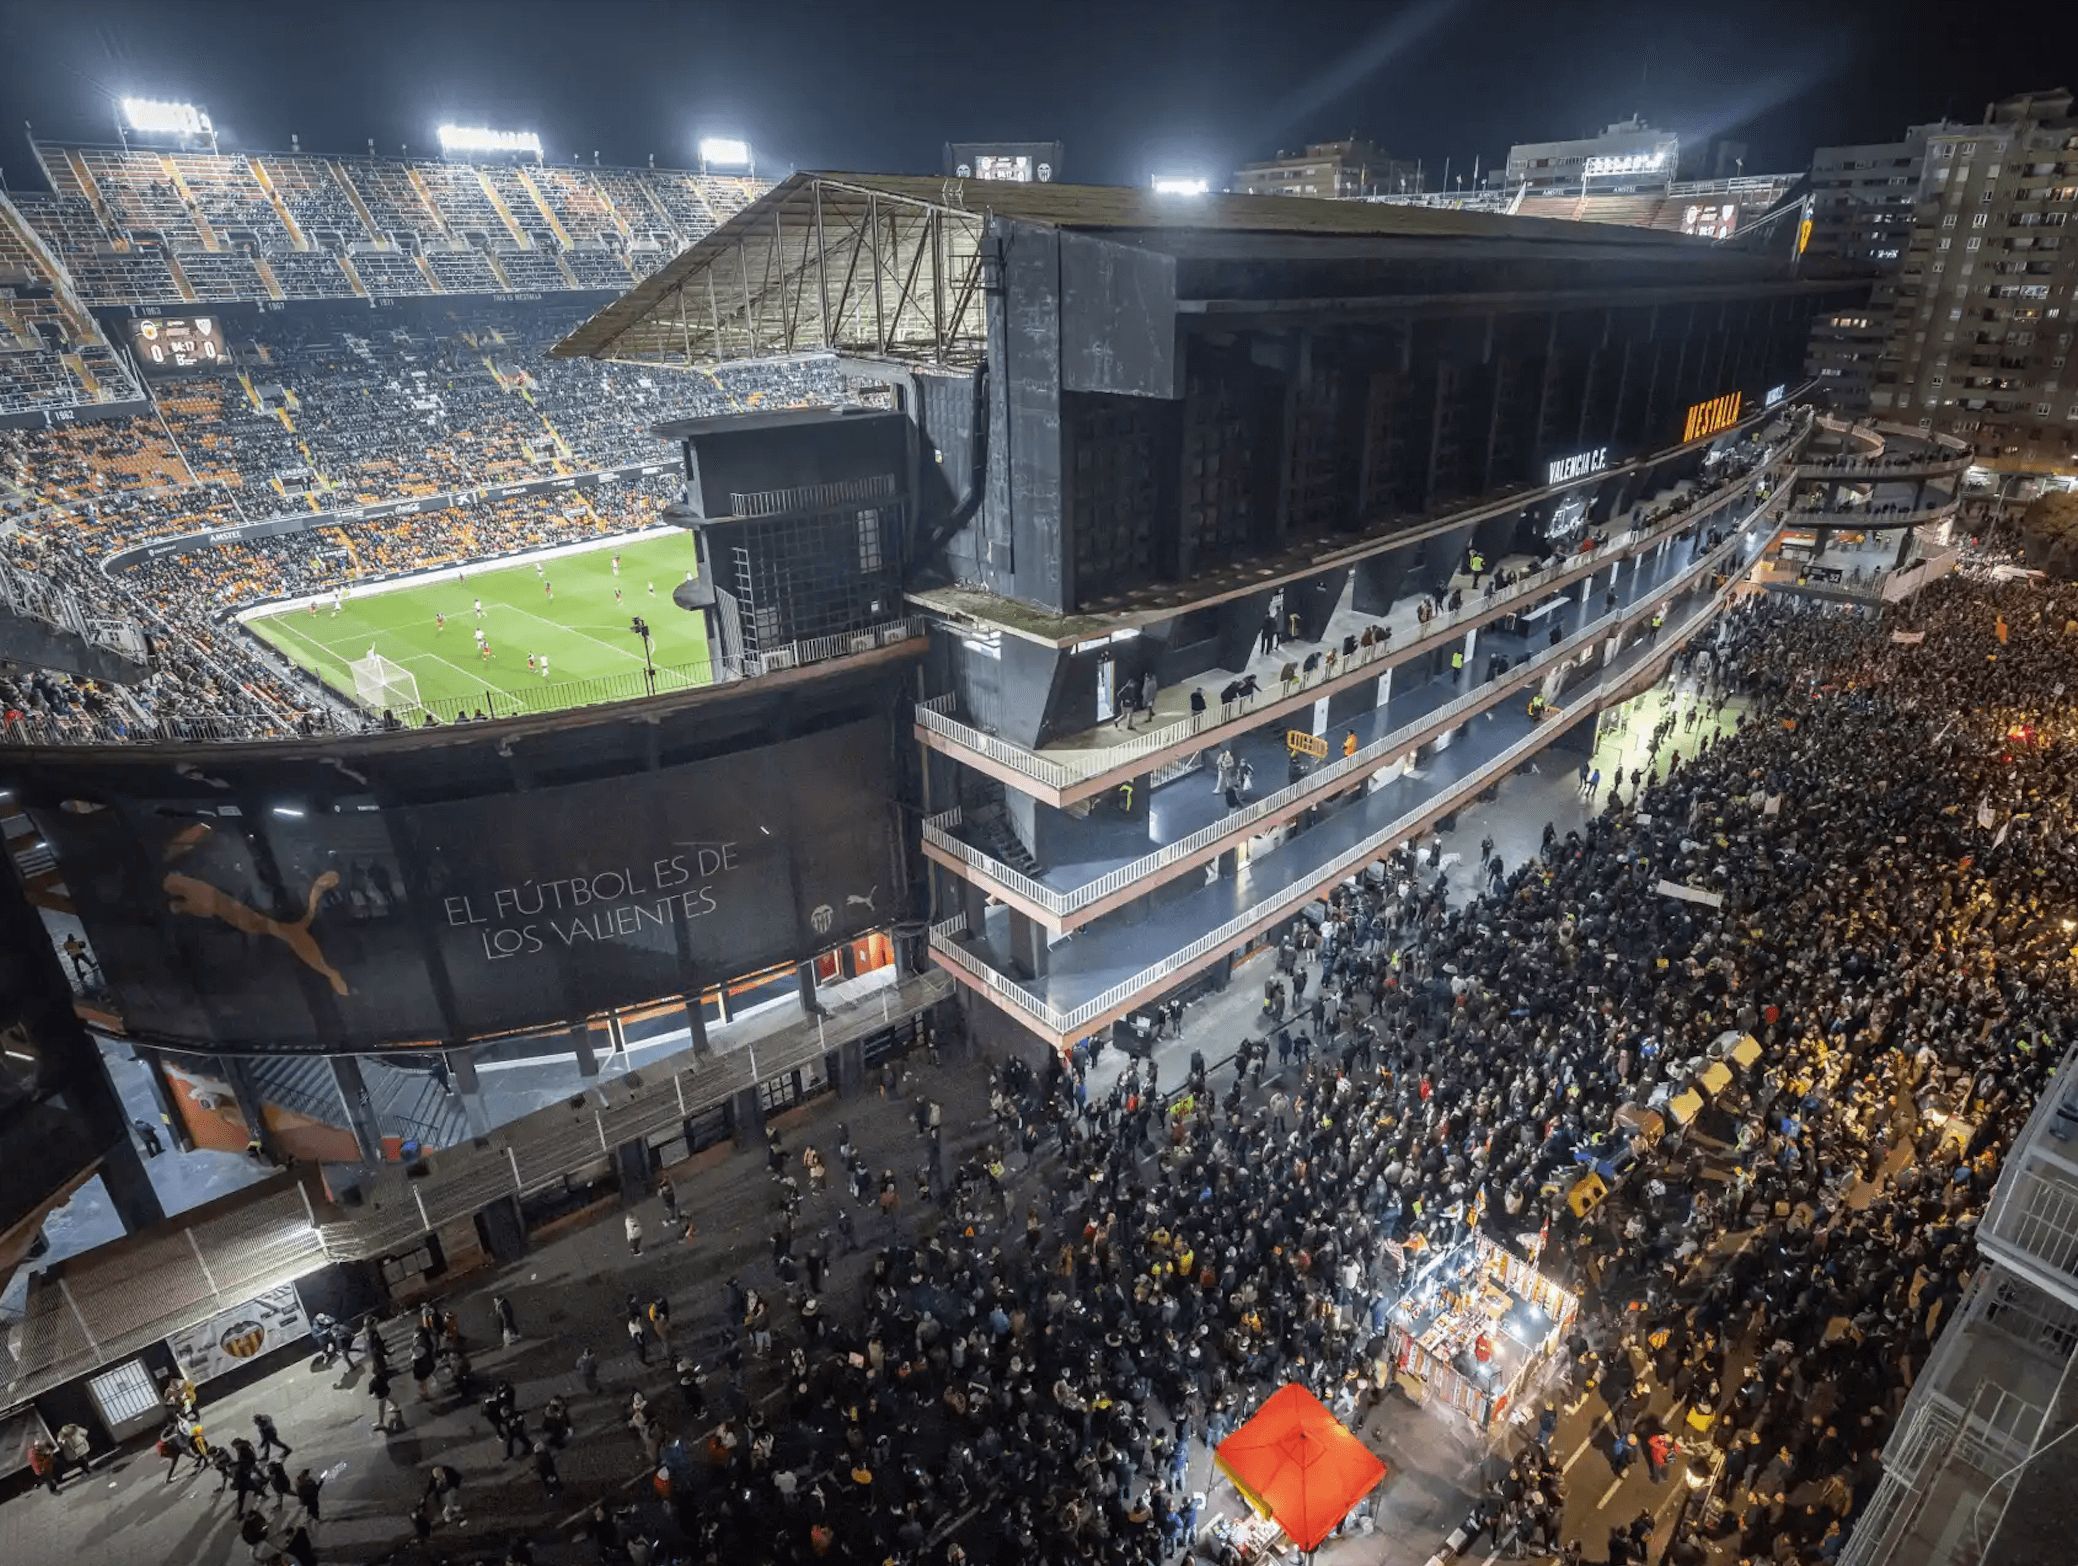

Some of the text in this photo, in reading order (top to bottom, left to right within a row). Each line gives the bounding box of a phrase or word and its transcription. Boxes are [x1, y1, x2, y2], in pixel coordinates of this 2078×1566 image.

[1683, 390, 1742, 443] MESTALLA
[1549, 452, 1591, 484] VALENCIA
[209, 530, 242, 542] AMSTEL
[444, 842, 739, 925] EL FÚTBOL ES DE
[482, 885, 717, 960] LOS VALIENTES
